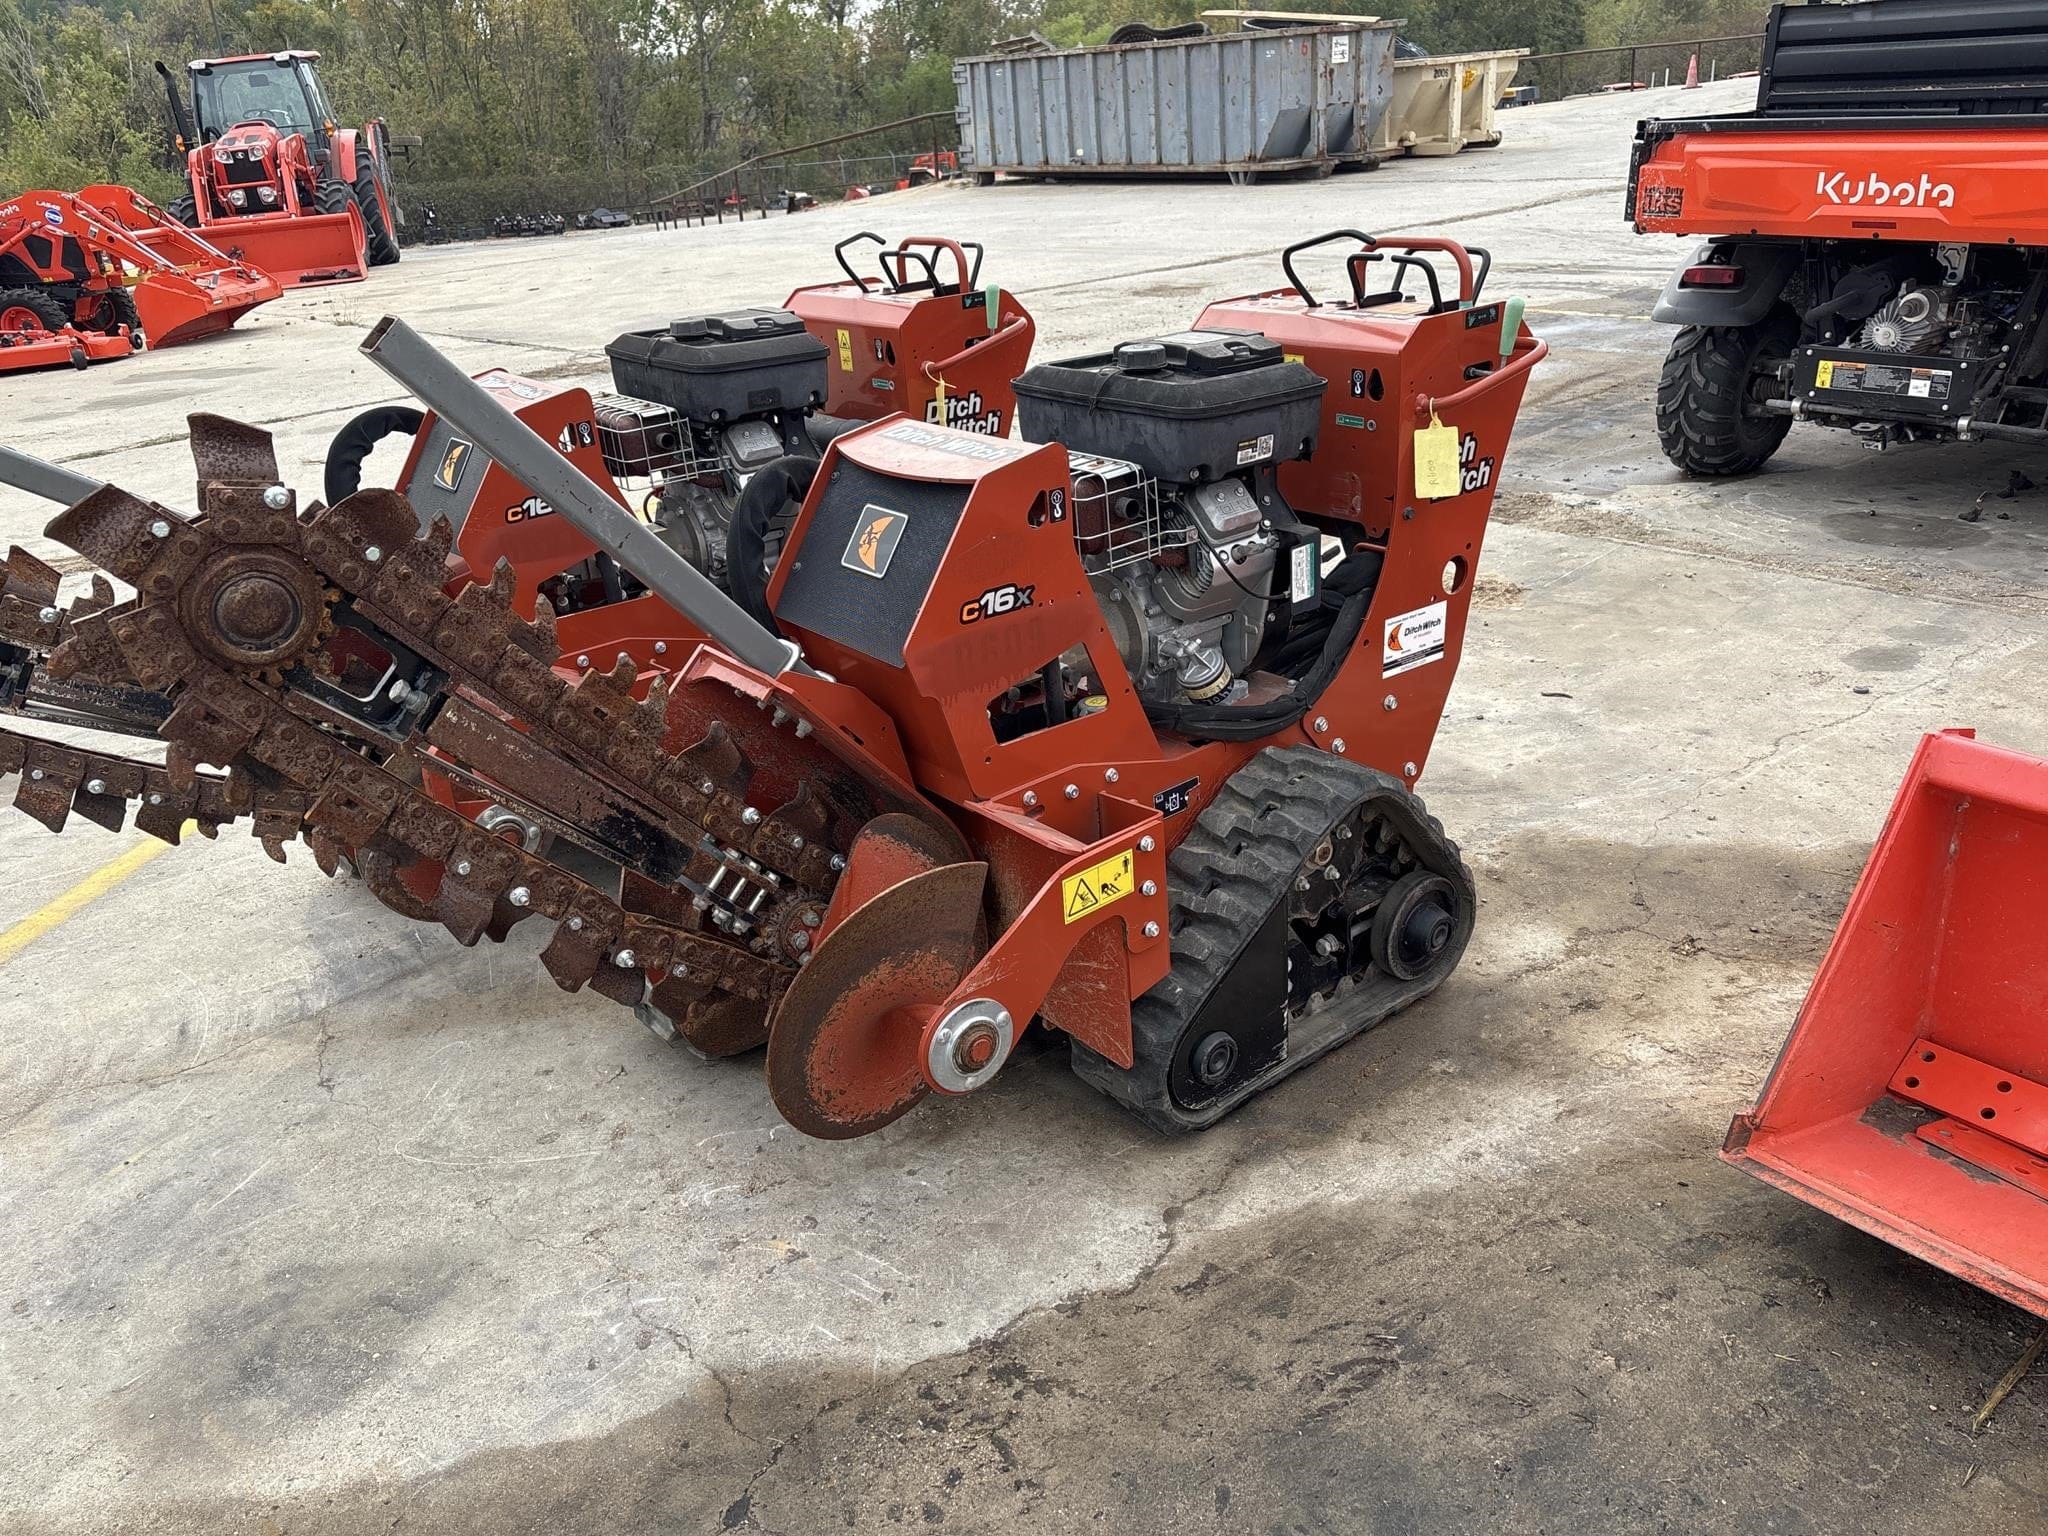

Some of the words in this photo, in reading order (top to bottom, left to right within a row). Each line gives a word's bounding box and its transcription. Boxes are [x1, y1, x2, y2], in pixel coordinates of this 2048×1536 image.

[1815, 171, 1955, 208] Kubota
[885, 425, 945, 447] Ditch
[940, 437, 1015, 460] Witch
